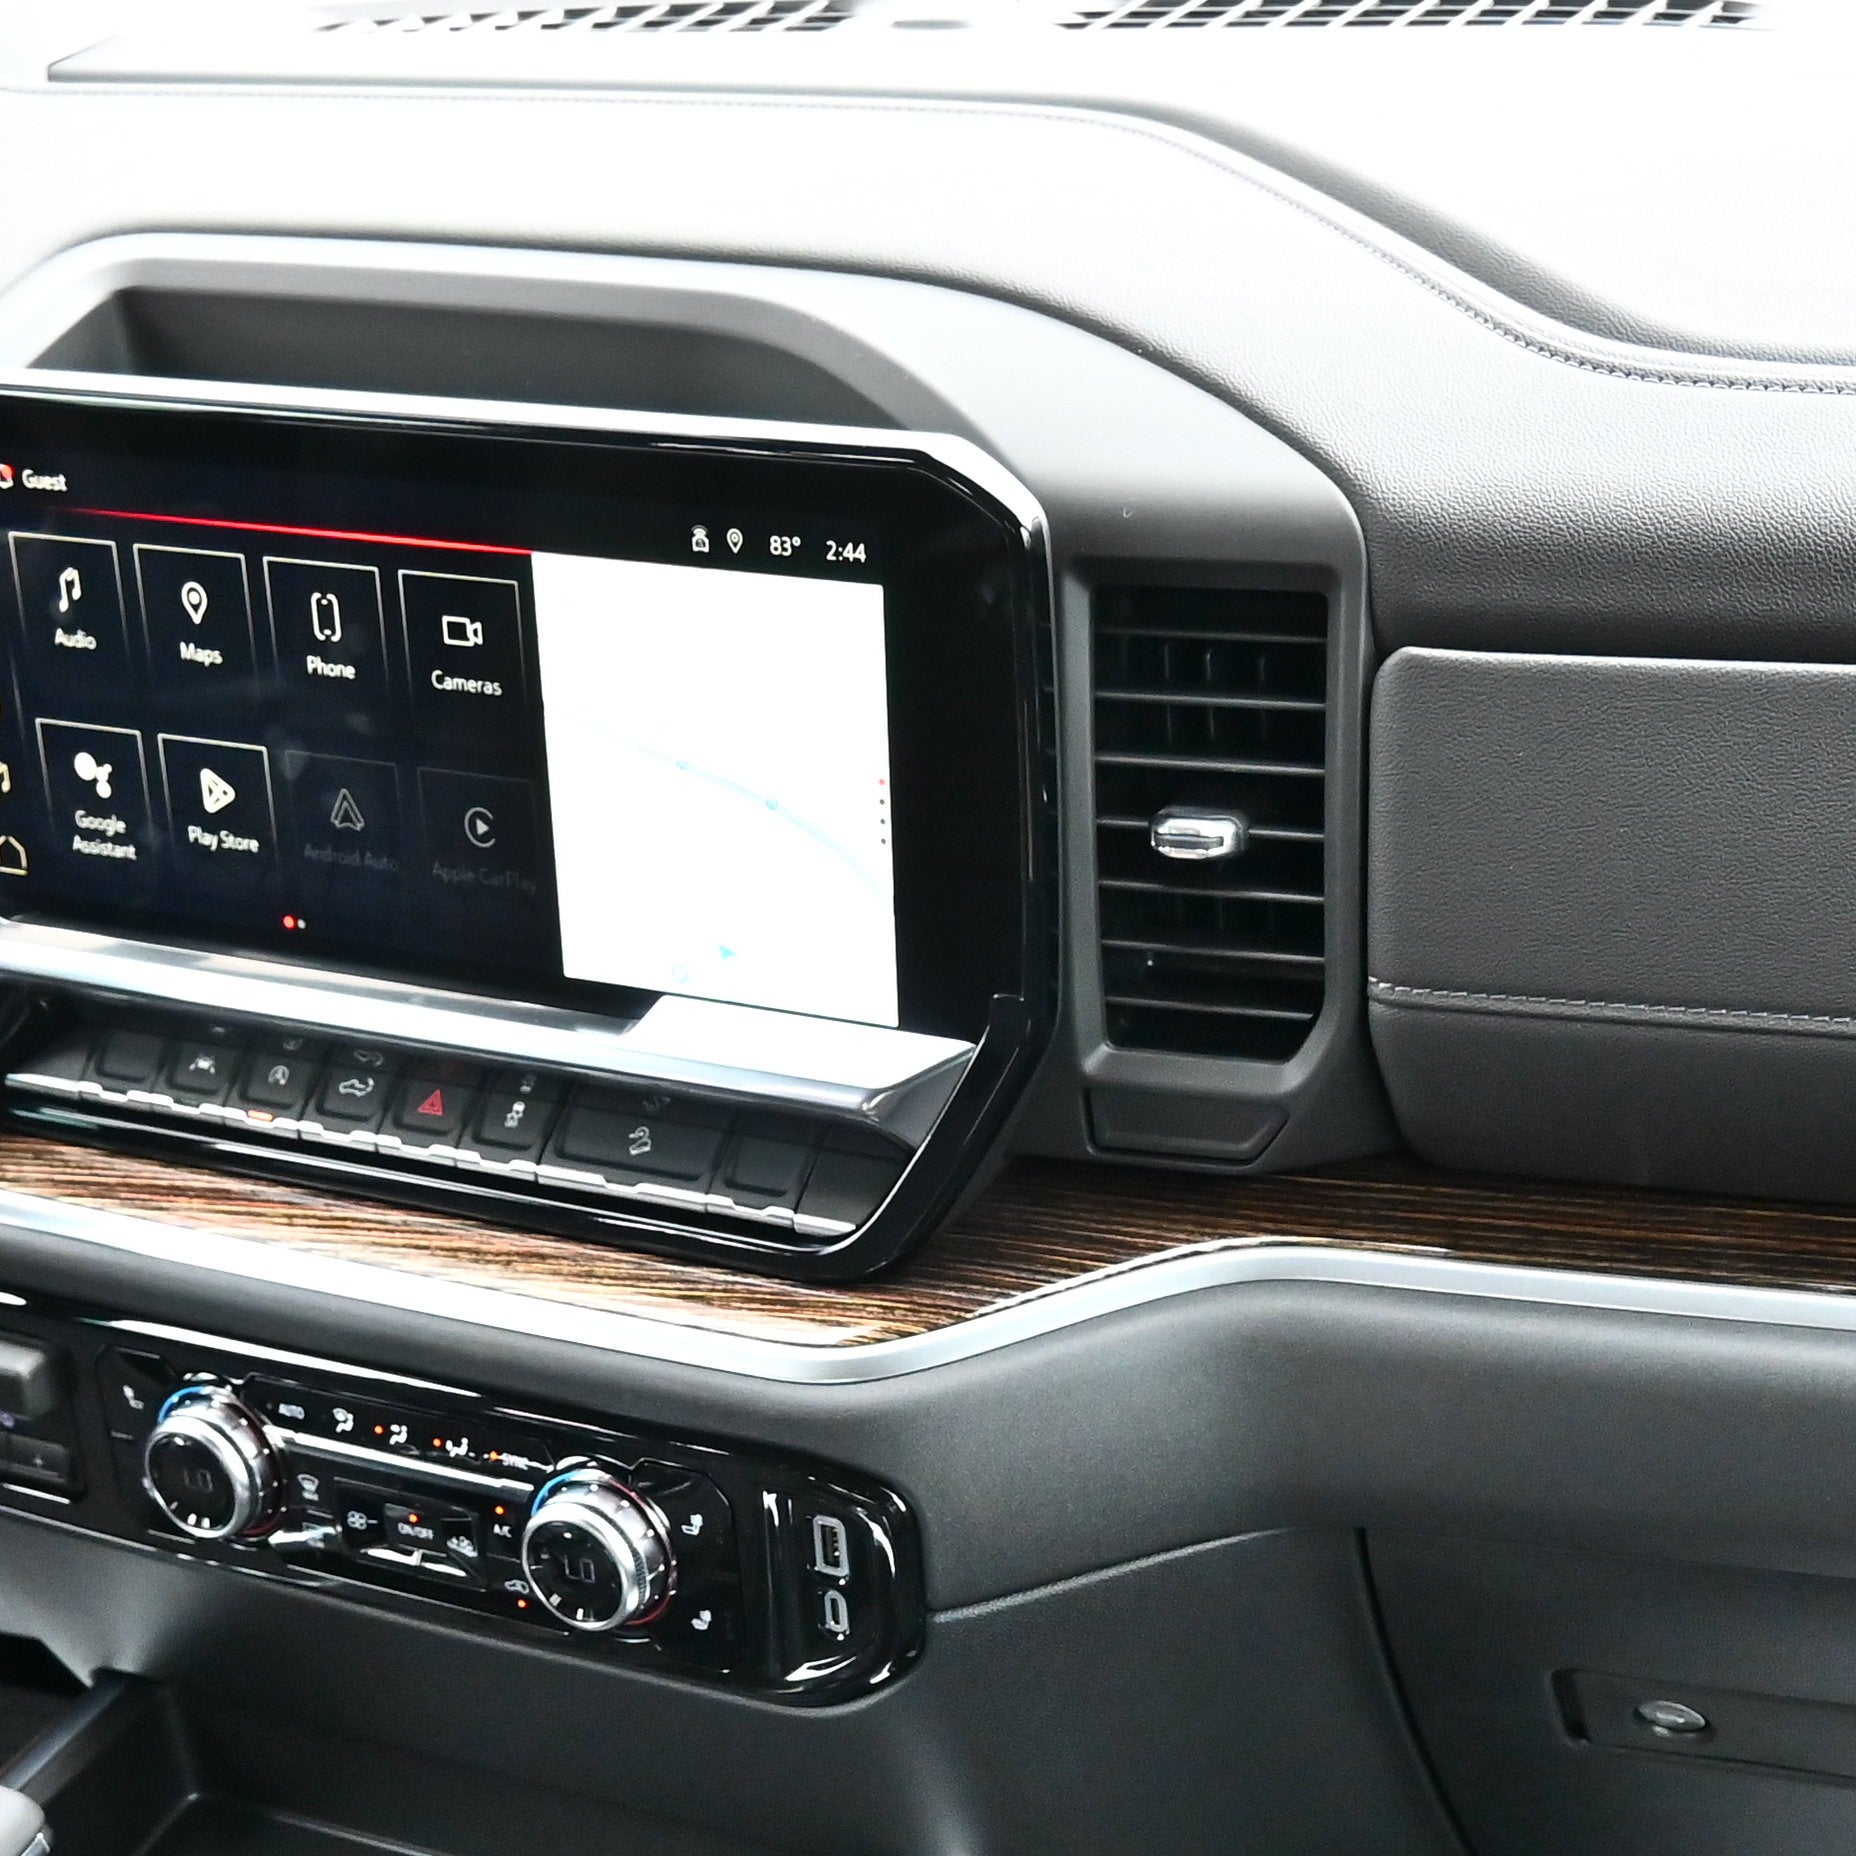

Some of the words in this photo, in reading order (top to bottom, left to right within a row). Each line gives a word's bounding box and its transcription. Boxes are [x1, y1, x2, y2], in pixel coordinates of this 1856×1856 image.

[22, 469, 67, 492] Guest
[769, 535, 801, 557] 83°
[826, 540, 866, 563] 2:44
[55, 628, 97, 650] Audio
[179, 641, 223, 667] Maps
[307, 655, 356, 680] Phone
[431, 670, 503, 697] Cameras
[75, 810, 126, 837] Google
[72, 834, 137, 861] Assistant
[188, 826, 218, 852] Play
[220, 830, 260, 854] Store
[304, 843, 361, 867] Android
[364, 851, 398, 872] Auto
[432, 862, 476, 884] Apple
[480, 867, 537, 895] CarPlay
